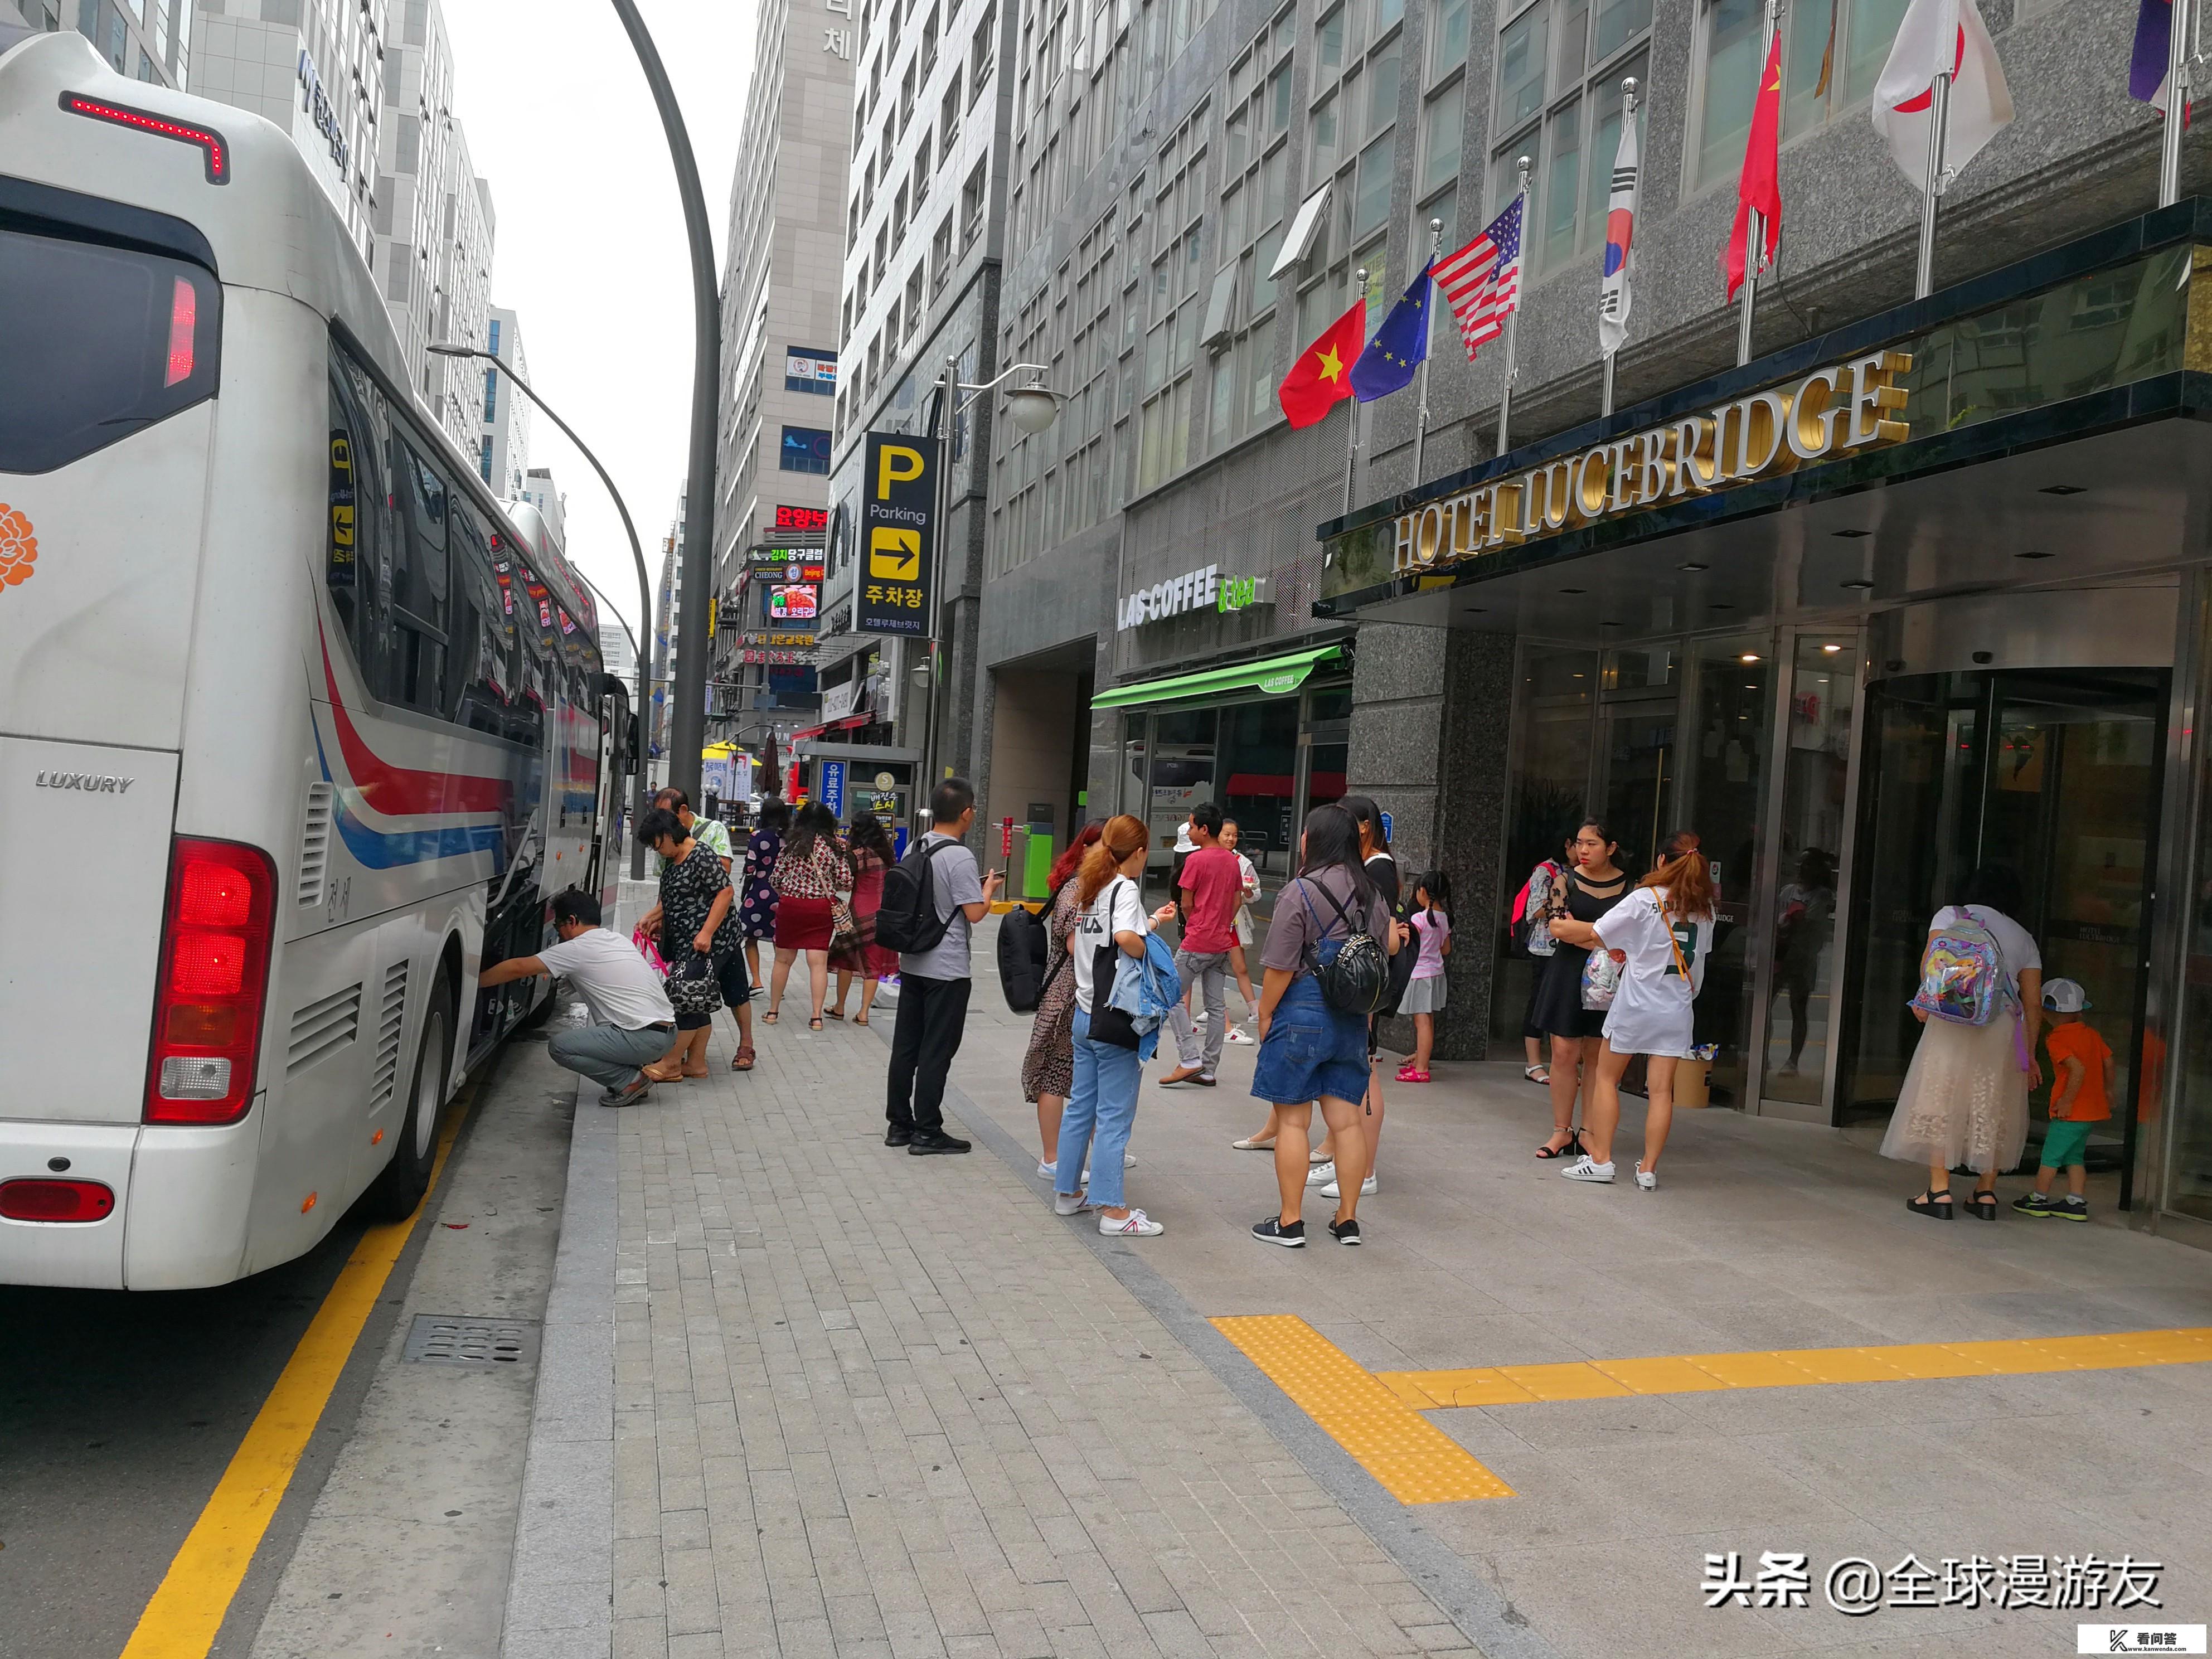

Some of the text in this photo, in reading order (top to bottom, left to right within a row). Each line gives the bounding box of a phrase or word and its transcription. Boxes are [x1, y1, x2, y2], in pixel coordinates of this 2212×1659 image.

[877, 444, 924, 500] P
[1391, 350, 1888, 574] HOTEL LUCEBRIDGE
[870, 504, 926, 525] Parking
[804, 569, 821, 578] Beijing
[865, 585, 923, 608] 주차장
[1117, 589, 1146, 632] LAS
[1149, 564, 1217, 621] COFFEE
[1231, 575, 1256, 608] tea
[1264, 677, 1274, 688] LAS
[1274, 675, 1294, 686] COFFEE
[36, 770, 135, 793] LUXURY
[826, 764, 840, 814] 유료주차
[873, 801, 895, 811] 스시
[1075, 917, 1103, 934] FILA
